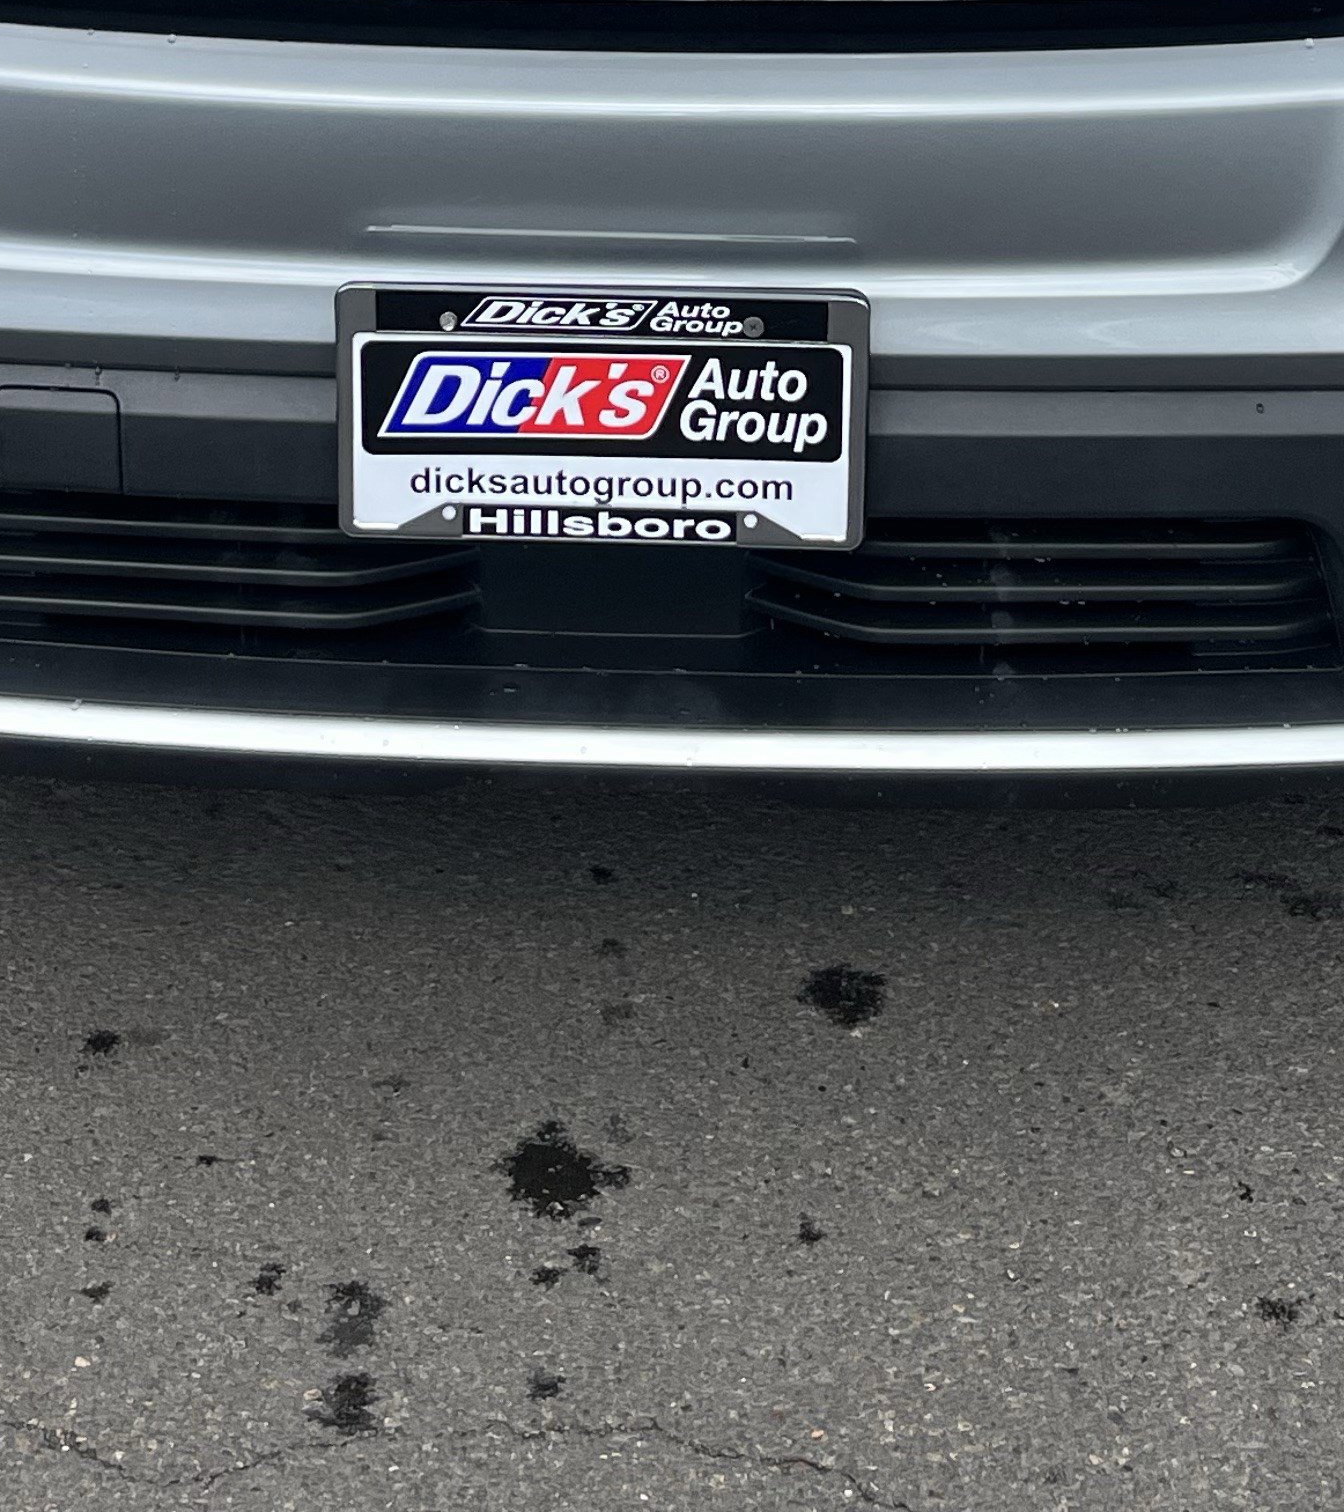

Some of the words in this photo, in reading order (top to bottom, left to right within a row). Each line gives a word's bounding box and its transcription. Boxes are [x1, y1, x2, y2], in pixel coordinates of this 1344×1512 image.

[475, 295, 636, 326] Dick's
[657, 301, 731, 319] Auto
[650, 315, 744, 337] Group
[688, 357, 808, 404] Auto
[679, 399, 828, 453] Group
[409, 466, 794, 506] dicksautogroup.com
[468, 507, 733, 541] Hillsboro
